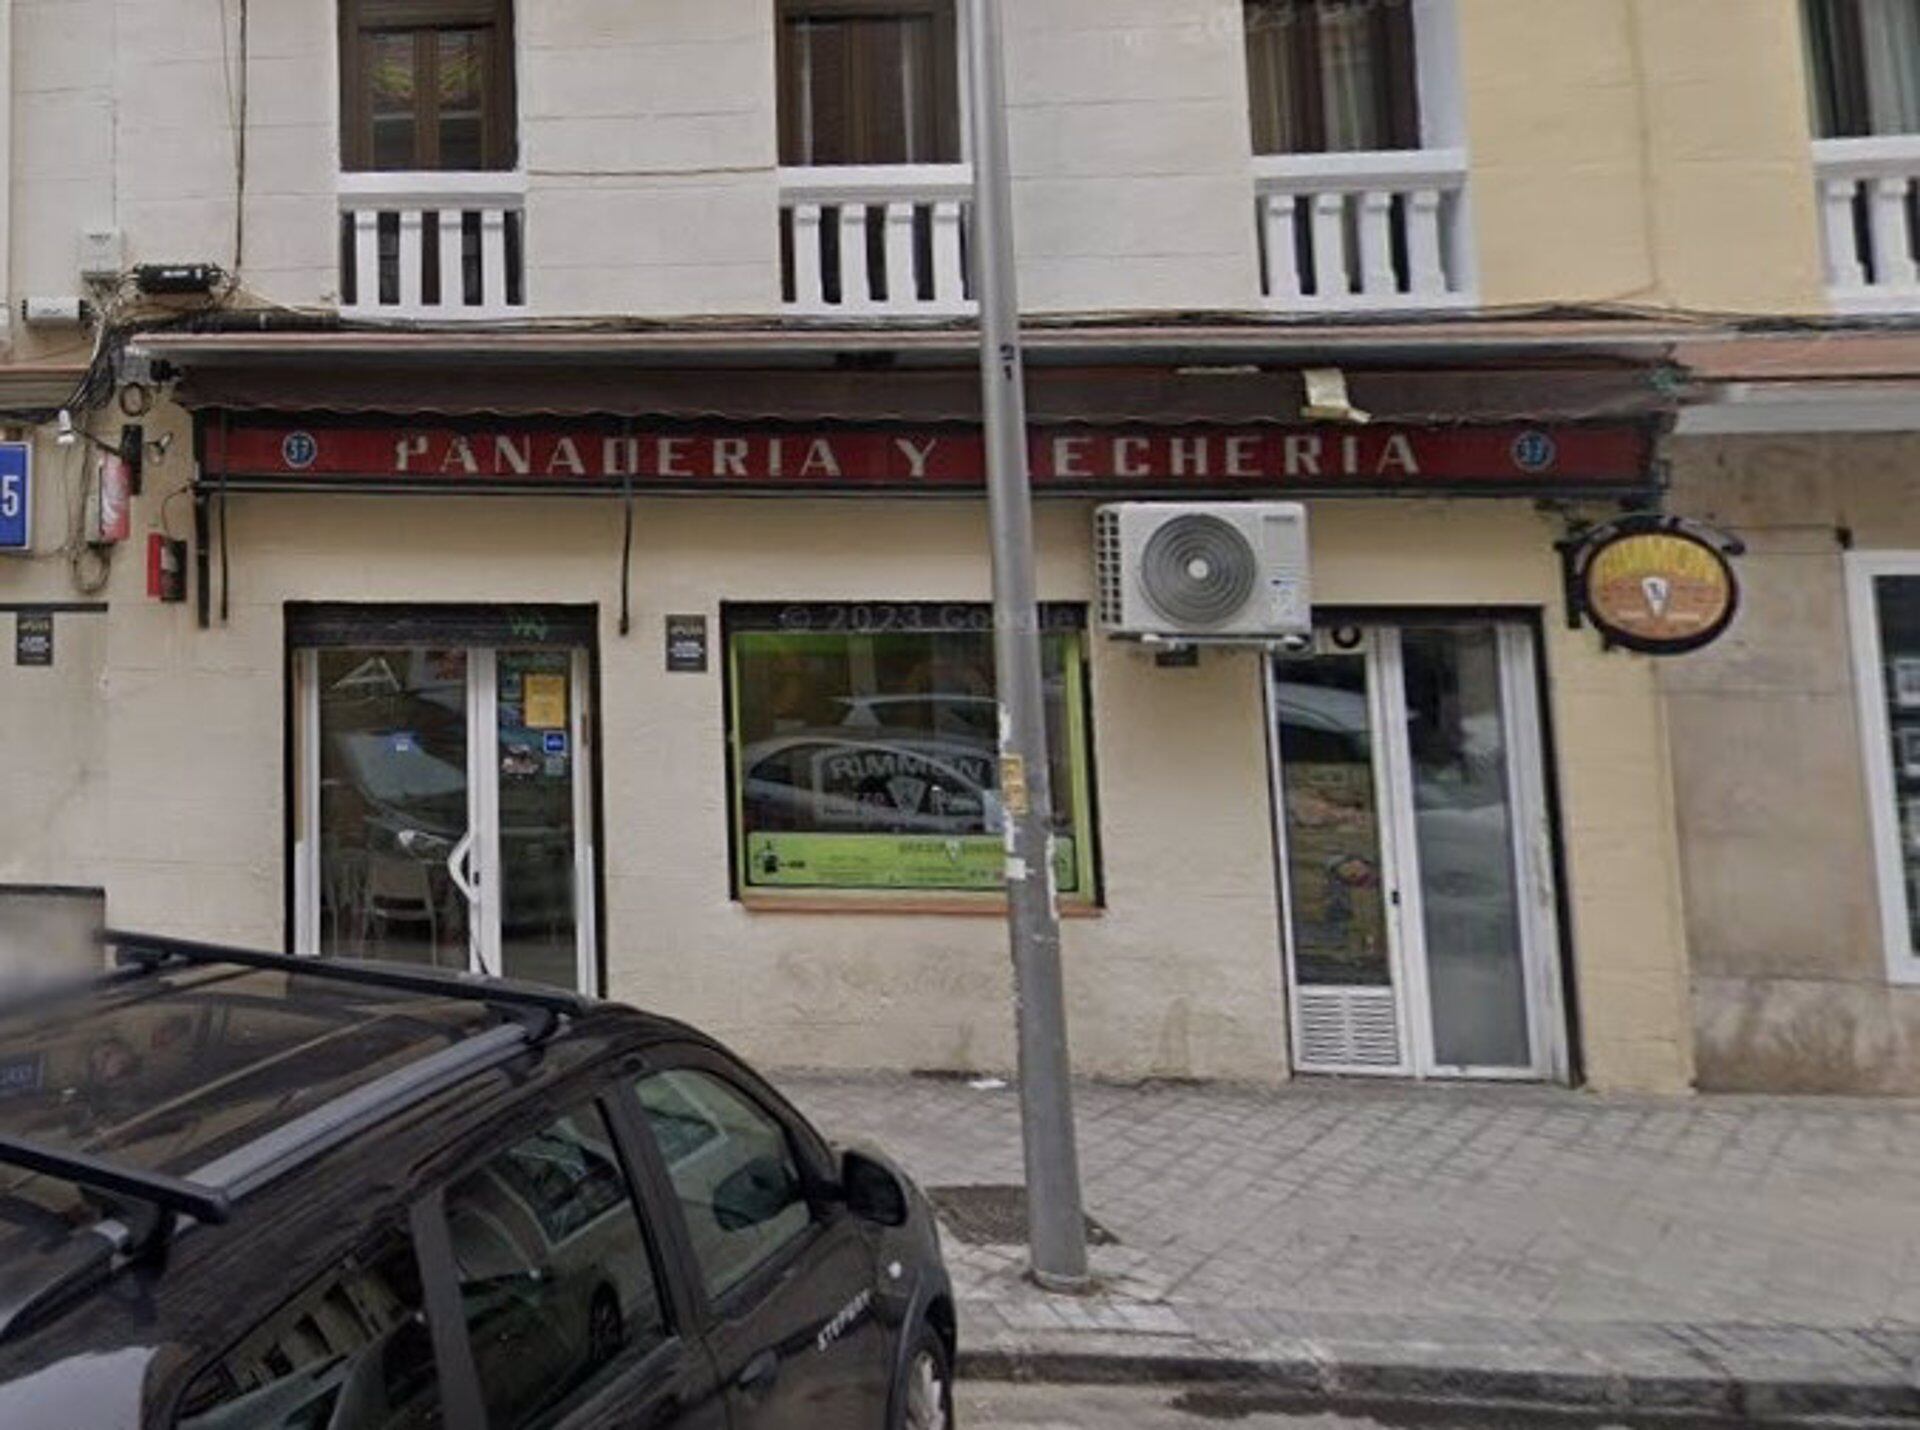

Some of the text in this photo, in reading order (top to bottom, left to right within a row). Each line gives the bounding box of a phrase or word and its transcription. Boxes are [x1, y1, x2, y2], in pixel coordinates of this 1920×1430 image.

[395, 433, 1420, 478] PANADERIA Y ECHERIA
[2, 474, 19, 517] 5
